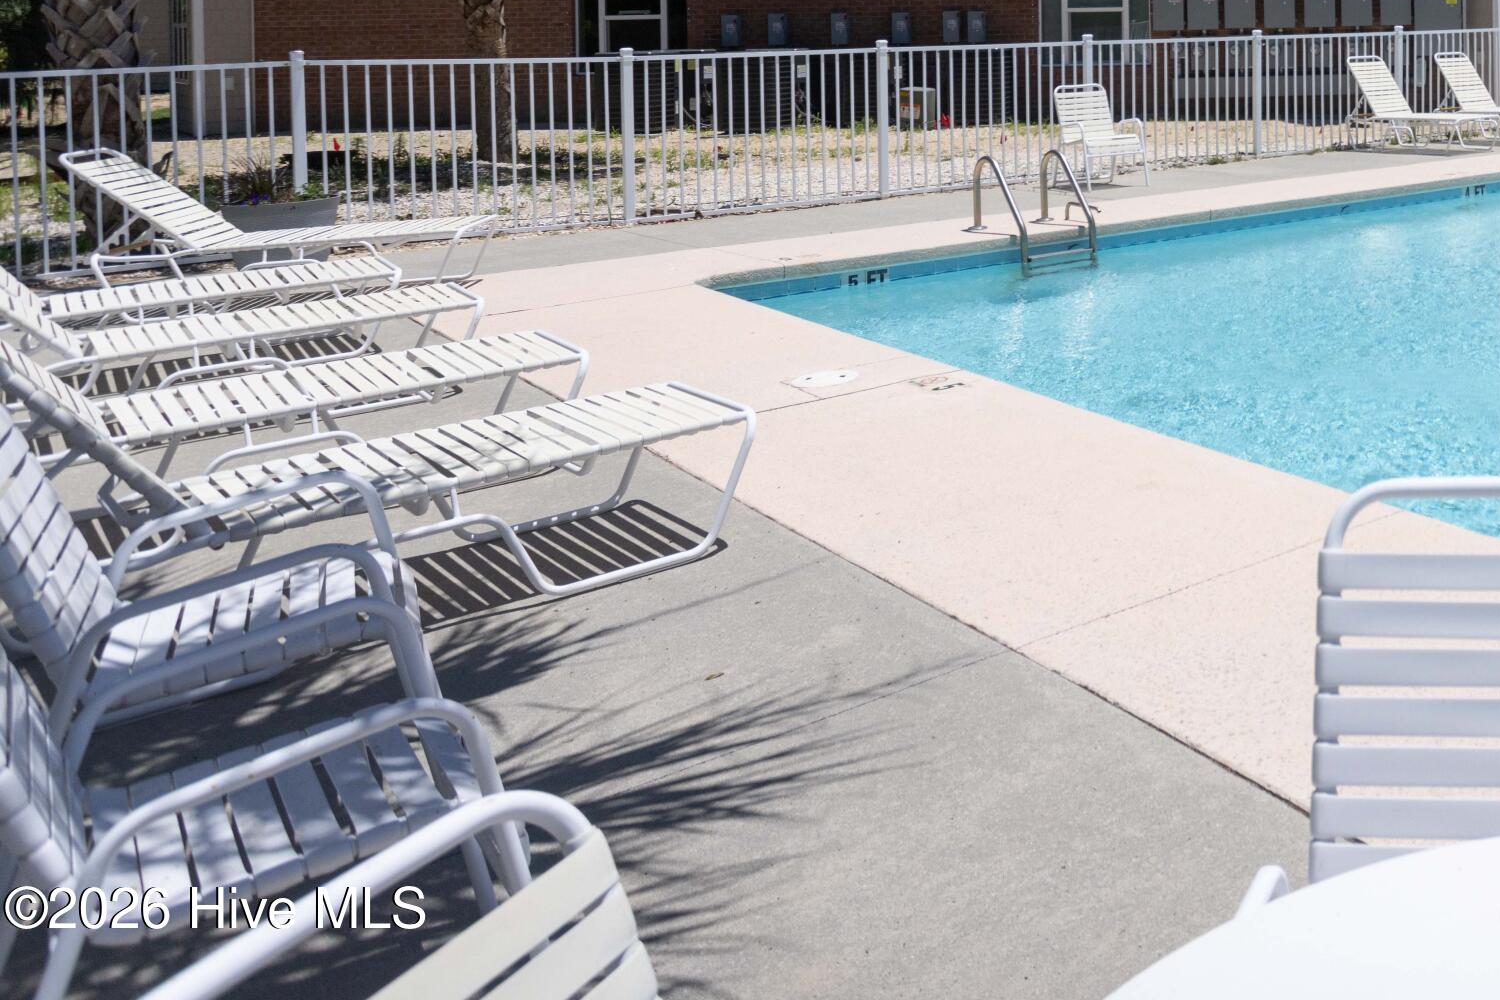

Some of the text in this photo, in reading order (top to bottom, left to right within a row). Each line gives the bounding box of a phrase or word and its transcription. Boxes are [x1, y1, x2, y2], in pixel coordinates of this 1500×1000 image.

[1474, 184, 1486, 196] FT
[848, 268, 888, 286] 5 FT
